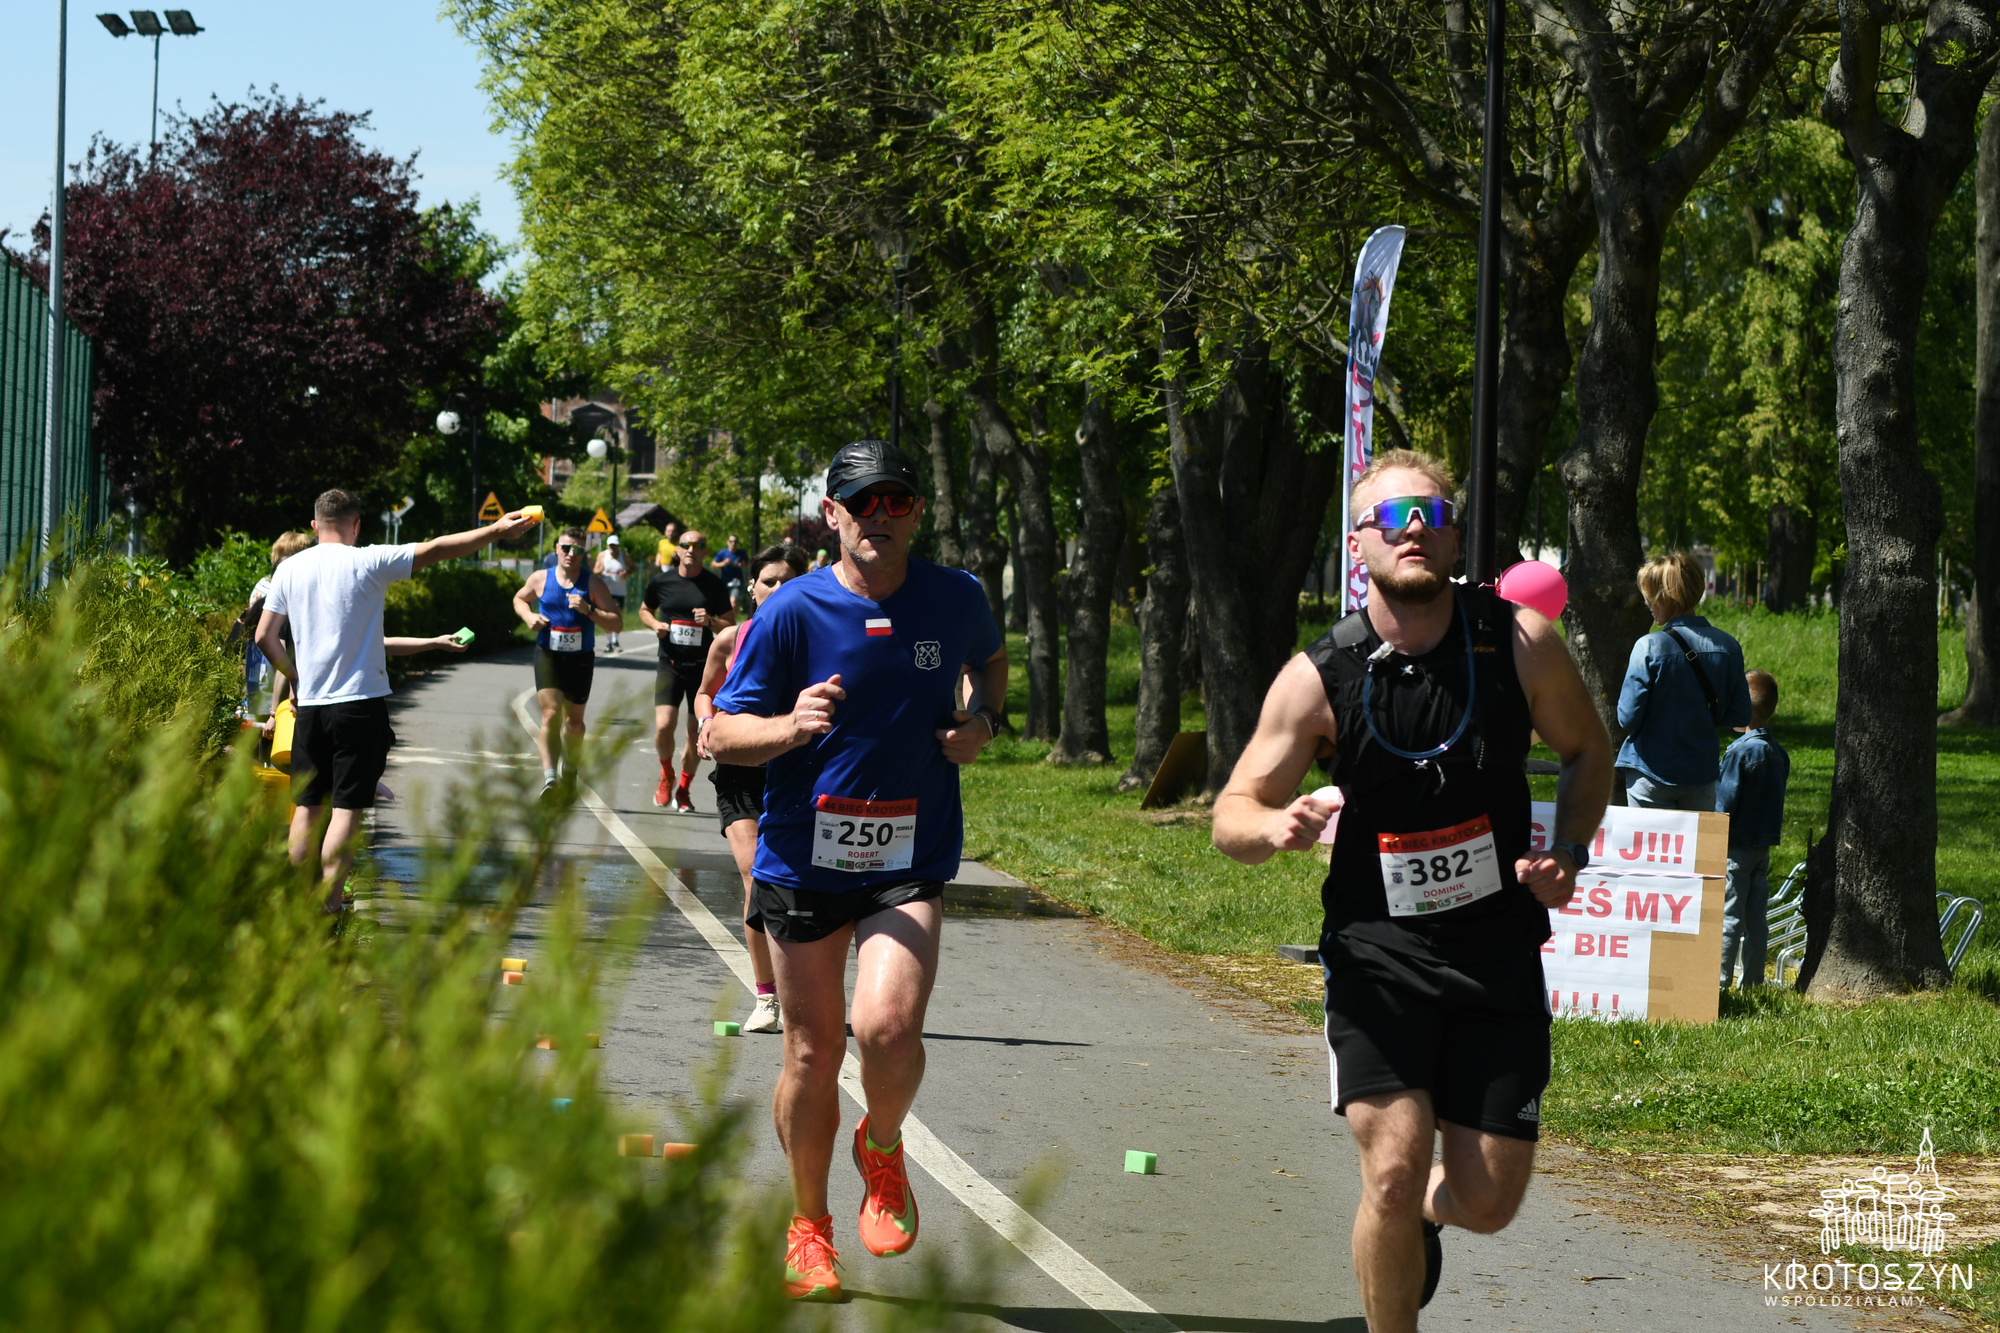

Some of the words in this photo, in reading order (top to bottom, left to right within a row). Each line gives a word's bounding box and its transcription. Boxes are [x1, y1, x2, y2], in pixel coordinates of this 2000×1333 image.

[558, 634, 576, 644] 155
[678, 627, 696, 637] 362
[824, 802, 836, 810] 44
[838, 803, 863, 814] BIEG
[866, 803, 913, 815] KROTOSA
[838, 821, 893, 847] 250
[1401, 838, 1428, 850] BIEG
[1406, 848, 1473, 887] 382
[1423, 882, 1465, 898] DOMINIK
[1624, 890, 1693, 924] MY
[1574, 932, 1629, 958] BIE
